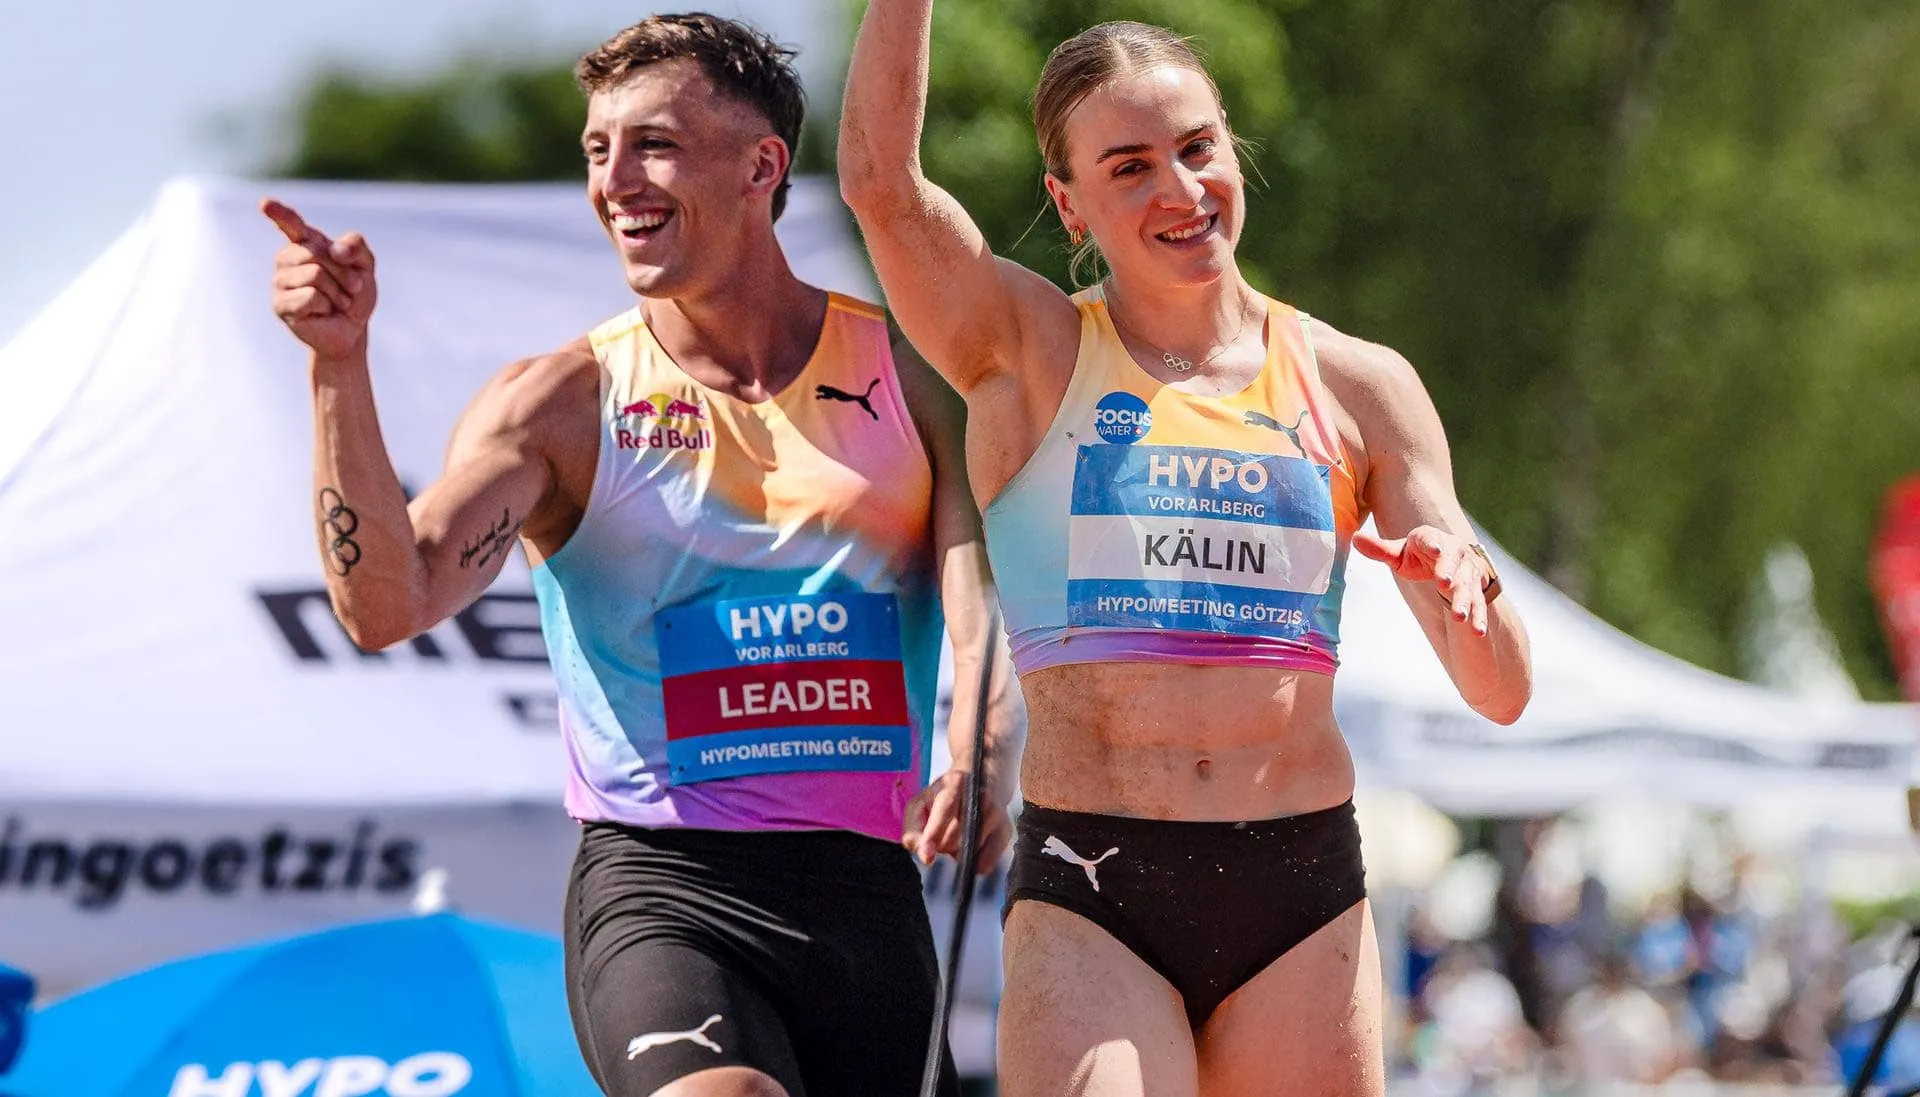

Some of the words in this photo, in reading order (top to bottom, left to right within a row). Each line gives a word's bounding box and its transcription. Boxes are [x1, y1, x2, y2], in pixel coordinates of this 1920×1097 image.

[1095, 409, 1153, 427] FOCUS
[617, 427, 663, 449] Red
[667, 428, 711, 450] Bull
[1149, 454, 1268, 493] HYPO
[1149, 496, 1265, 518] VORARLBERG
[1144, 528, 1266, 574] KÄLIN
[730, 601, 849, 640] HYPO
[1097, 596, 1235, 618] HYPOMEETING
[1240, 602, 1303, 625] GÖTZIS
[735, 642, 849, 661] VORARLBERG
[718, 678, 873, 718] LEADER
[701, 739, 834, 765] HYPOMEETING
[838, 736, 893, 756] GÖTZIS
[166, 1051, 474, 1097] HYPO
